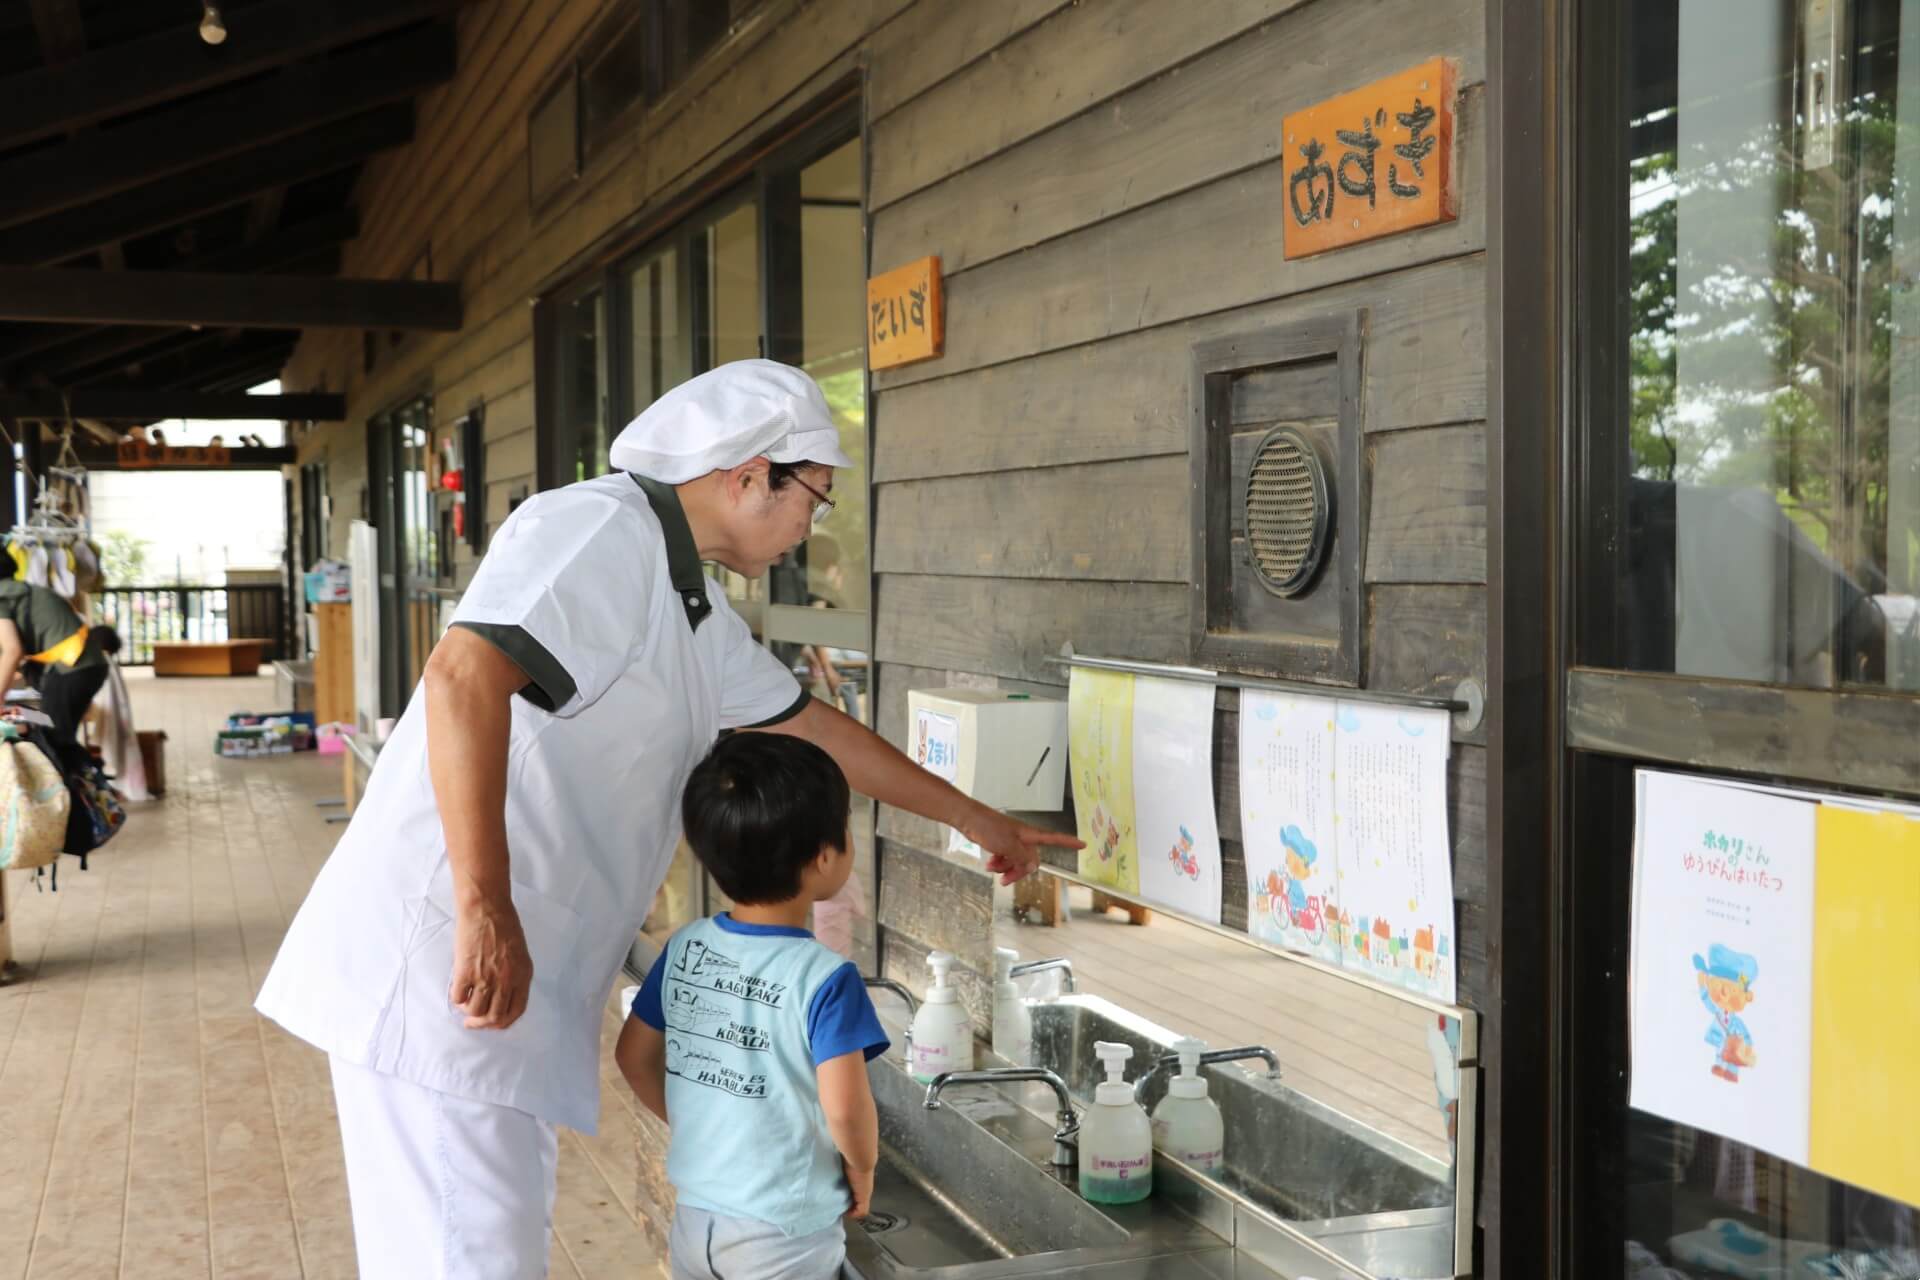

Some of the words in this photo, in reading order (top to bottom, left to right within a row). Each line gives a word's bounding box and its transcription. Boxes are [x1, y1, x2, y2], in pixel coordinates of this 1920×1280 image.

[1290, 97, 1436, 226] あずき
[871, 280, 927, 346] だいず
[1683, 853, 1783, 891] ゆうびんはいたつ
[698, 1071, 765, 1095] HAYABUSA
